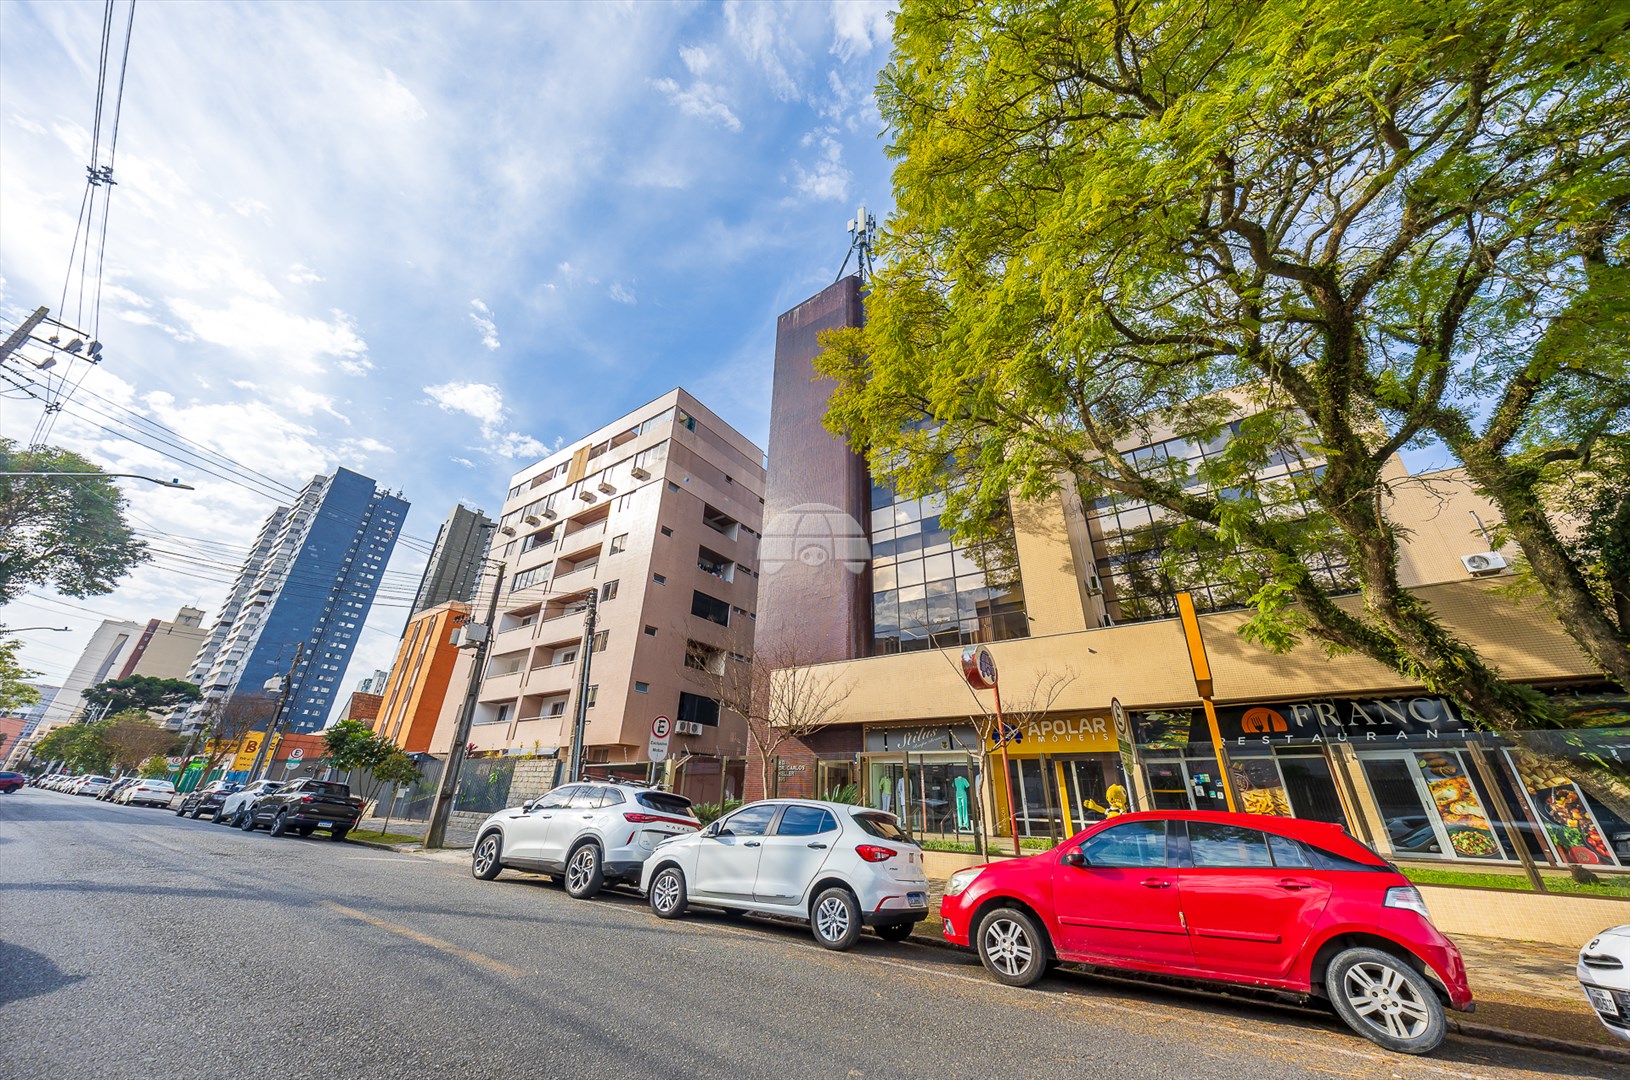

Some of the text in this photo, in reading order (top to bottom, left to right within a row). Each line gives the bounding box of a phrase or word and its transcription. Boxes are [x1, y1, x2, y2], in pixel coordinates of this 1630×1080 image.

[1289, 697, 1459, 728] FRANCI
[657, 719, 666, 734] E
[1027, 717, 1107, 736] APOLAR
[897, 727, 938, 749] Stilus
[1027, 733, 1109, 743] IMÓVEIS
